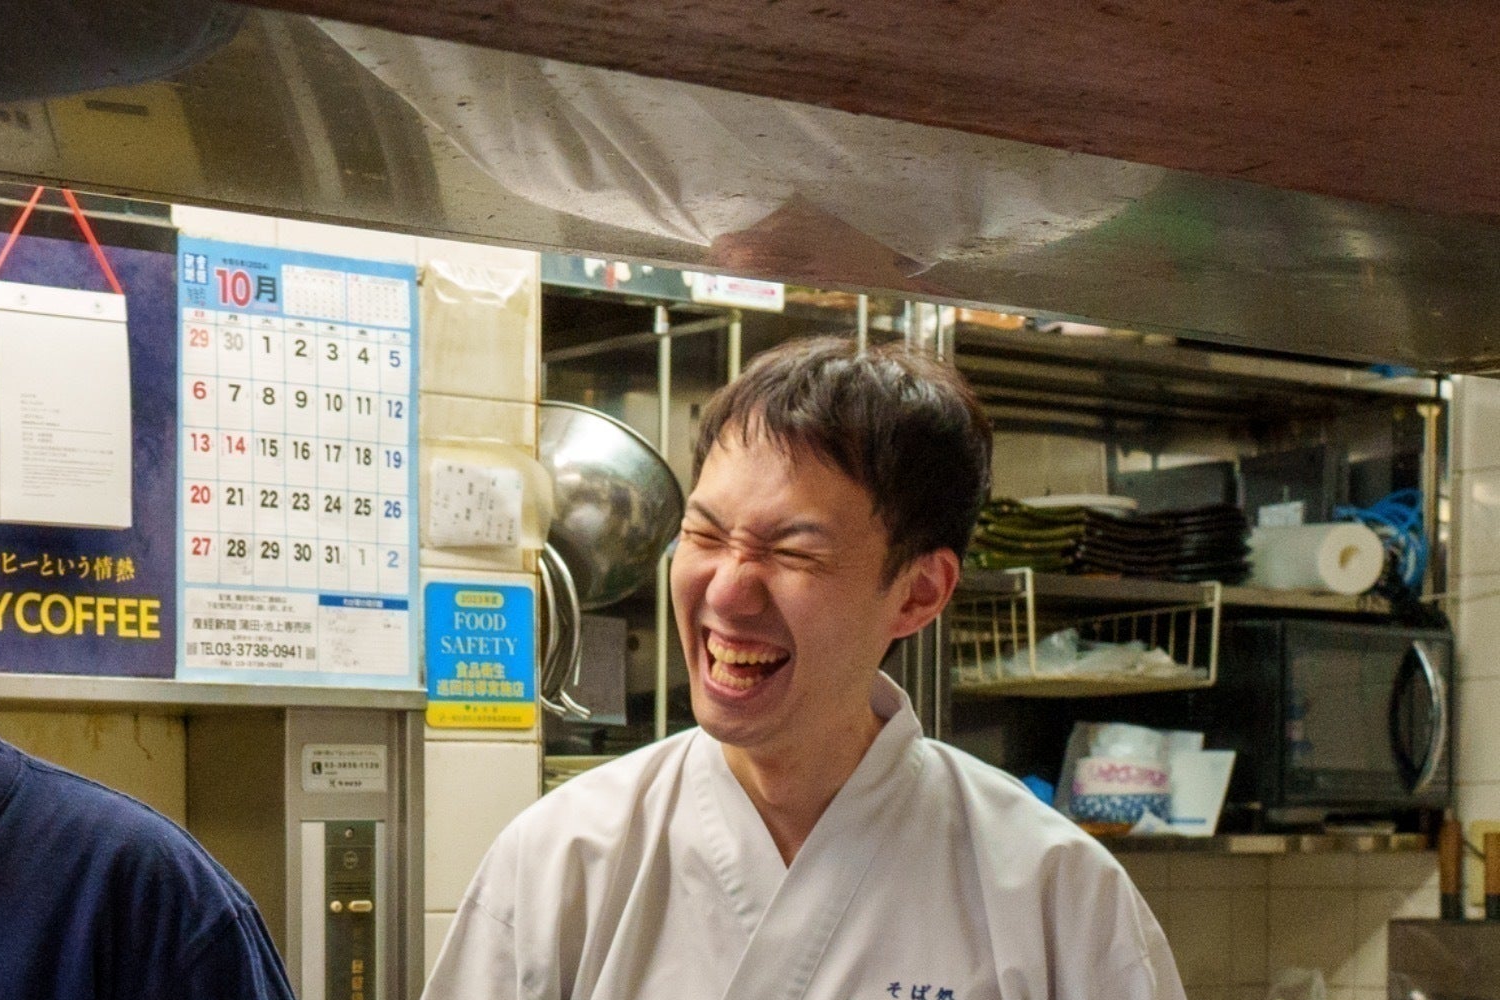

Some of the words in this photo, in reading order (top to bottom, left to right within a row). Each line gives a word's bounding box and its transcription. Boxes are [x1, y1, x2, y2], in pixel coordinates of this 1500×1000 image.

[190, 329, 209, 347] 29
[224, 332, 243, 351] 30
[262, 336, 271, 353] 1
[294, 340, 307, 357] 2
[327, 344, 339, 361] 3
[357, 347, 369, 364] 4
[389, 351, 401, 368] 5
[193, 381, 207, 400] 6
[228, 384, 241, 402] 7
[262, 387, 275, 405] 8
[295, 391, 308, 408] 9
[325, 393, 343, 412] 10
[357, 397, 372, 415] 11
[387, 400, 403, 419] 12
[191, 433, 210, 452] 13
[226, 435, 246, 454] 14
[260, 438, 278, 457] 15
[293, 441, 311, 460] 16
[325, 445, 342, 463] 17
[356, 447, 372, 466] 18
[385, 451, 402, 469] 19
[191, 485, 211, 504] 20
[226, 487, 244, 506] 21
[260, 490, 278, 509] 22
[292, 493, 311, 511] 23
[324, 495, 342, 514] 24
[354, 498, 372, 516] 25
[384, 500, 402, 519] 26
[191, 537, 212, 556] 27
[227, 539, 247, 558] 28
[260, 541, 280, 560] 29
[294, 543, 312, 562] 30
[325, 546, 340, 564] 31
[360, 549, 367, 566] 1
[387, 551, 399, 568] 2
[15, 591, 161, 639] COFFEE
[454, 611, 507, 630] FOOD
[441, 636, 518, 655] SAFETY
